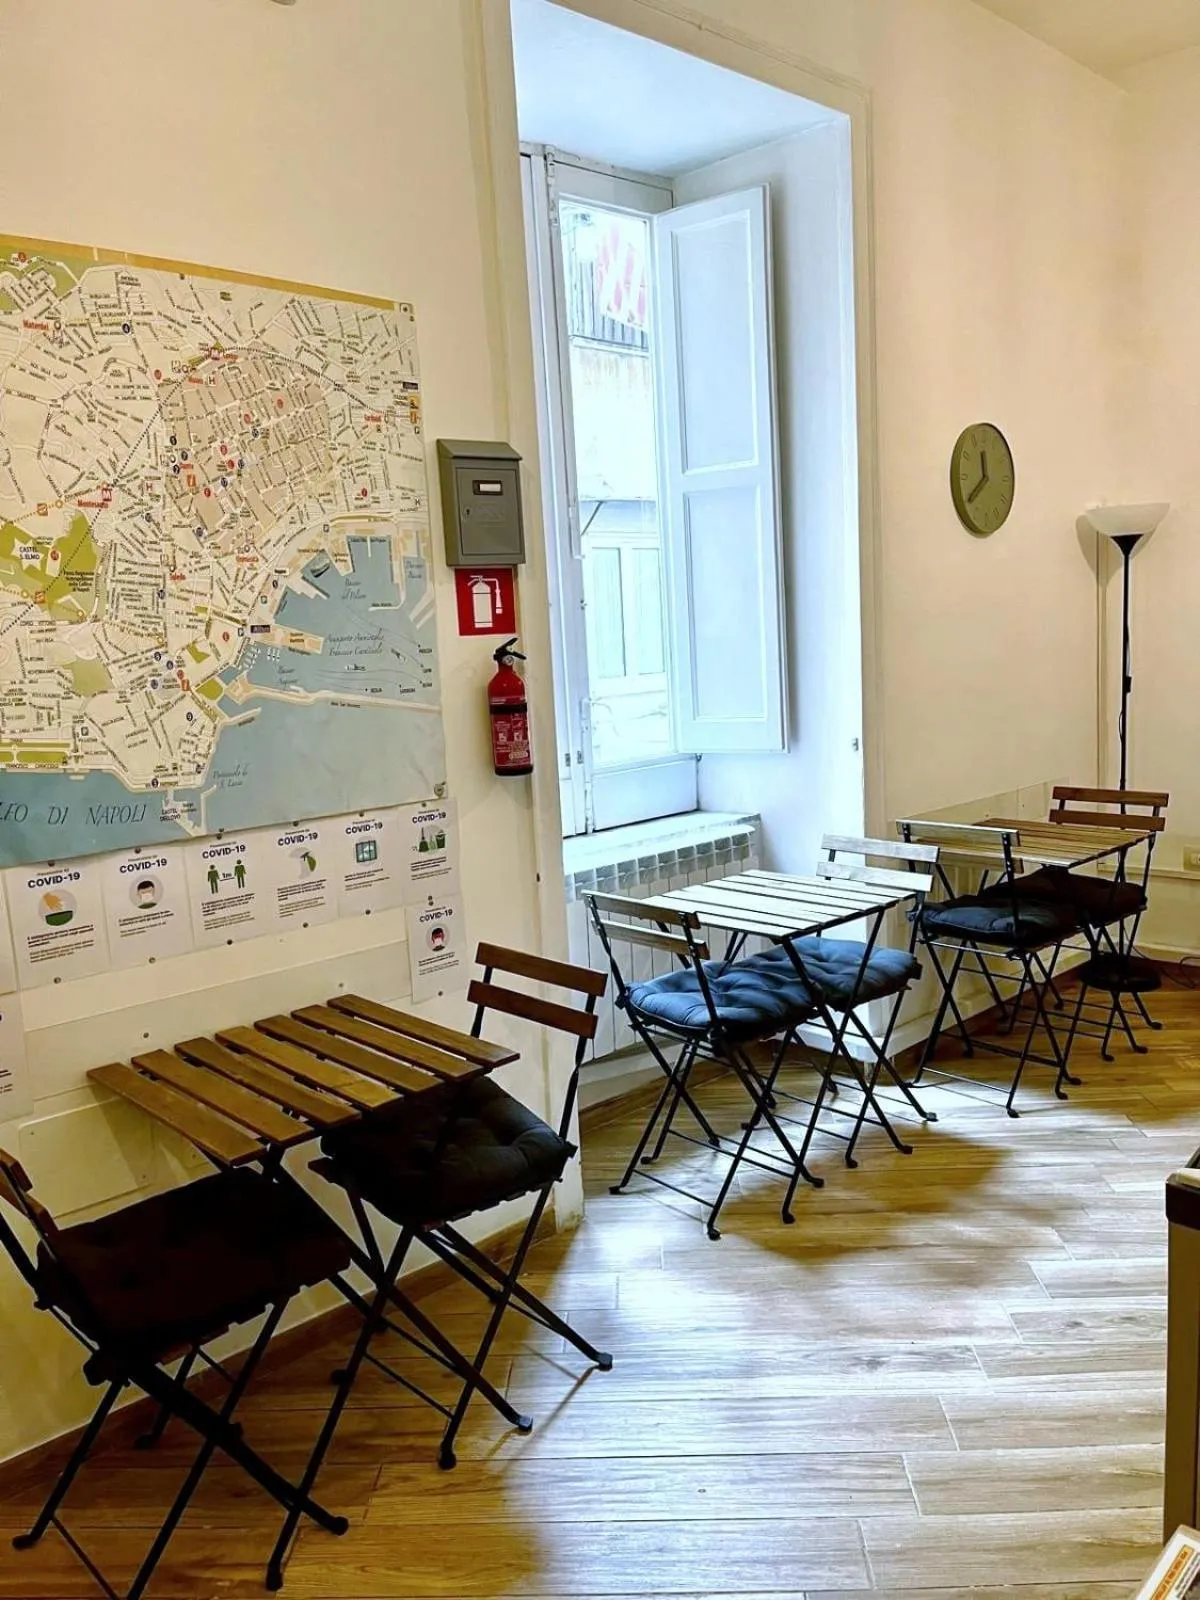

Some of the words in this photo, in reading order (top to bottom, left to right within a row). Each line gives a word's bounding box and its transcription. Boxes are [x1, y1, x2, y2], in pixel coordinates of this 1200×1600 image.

[0, 801, 28, 823] FO
[48, 806, 69, 825] DI
[86, 803, 147, 828] NAPOLI
[412, 812, 447, 823] COVID-19
[345, 822, 383, 835] COVID-19
[277, 832, 318, 846] COVID-19
[202, 844, 246, 859] COVID-19
[119, 857, 168, 873] COVID-19
[27, 871, 81, 889] COVID-19
[419, 908, 453, 922] COVID-19
